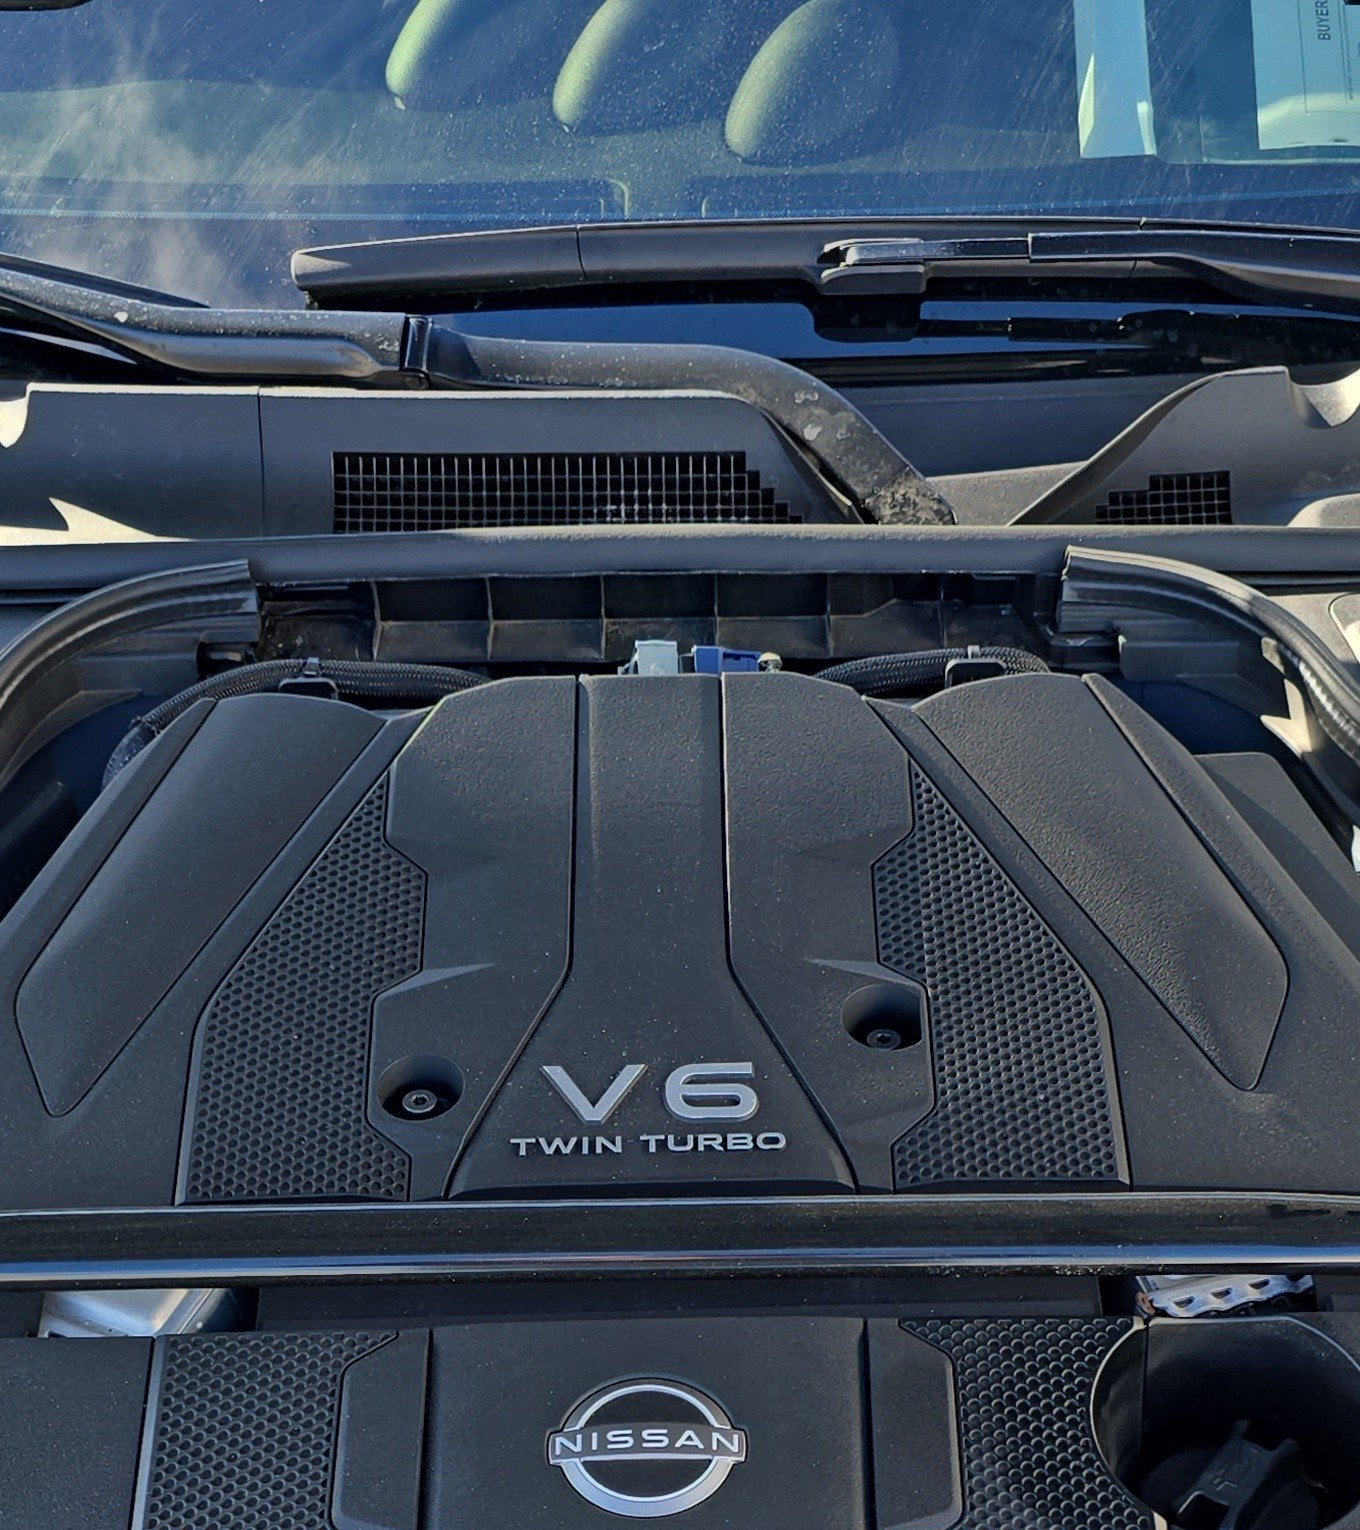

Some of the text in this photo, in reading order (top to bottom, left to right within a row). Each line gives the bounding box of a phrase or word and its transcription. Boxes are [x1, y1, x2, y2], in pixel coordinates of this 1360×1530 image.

[540, 1060, 759, 1124] V6
[509, 1131, 787, 1156] TWIN TURBO
[554, 1428, 739, 1456] NISSAN
